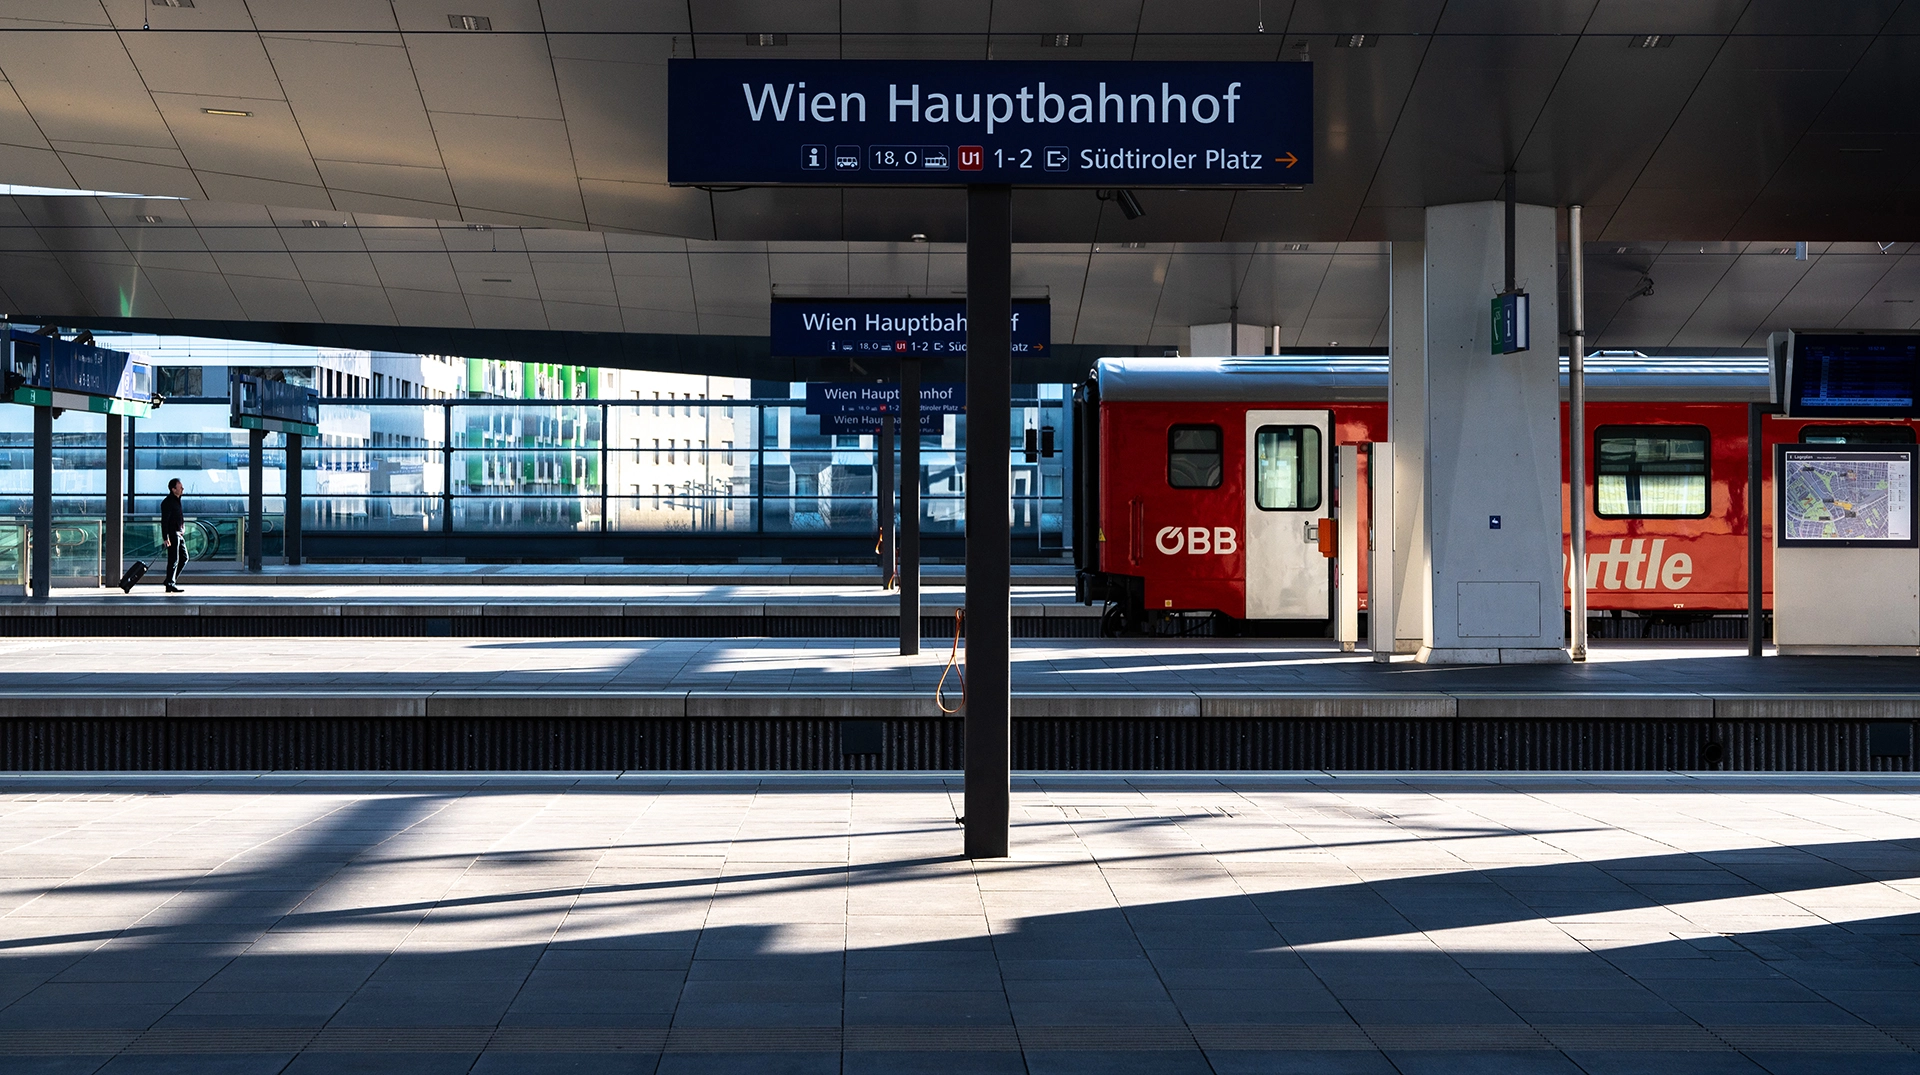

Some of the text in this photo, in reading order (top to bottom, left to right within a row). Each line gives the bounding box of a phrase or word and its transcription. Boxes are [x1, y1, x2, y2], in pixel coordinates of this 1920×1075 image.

[742, 81, 1242, 135] Wien Hauptbahnhof
[875, 147, 1263, 170] 18, O U1 1-2 Südtiroler Platz
[802, 312, 1020, 336] Wien Hauptbahf
[911, 341, 929, 352] 1-2
[824, 388, 857, 400] Wien
[833, 415, 859, 425] Wien
[1155, 526, 1238, 556] ÖBB
